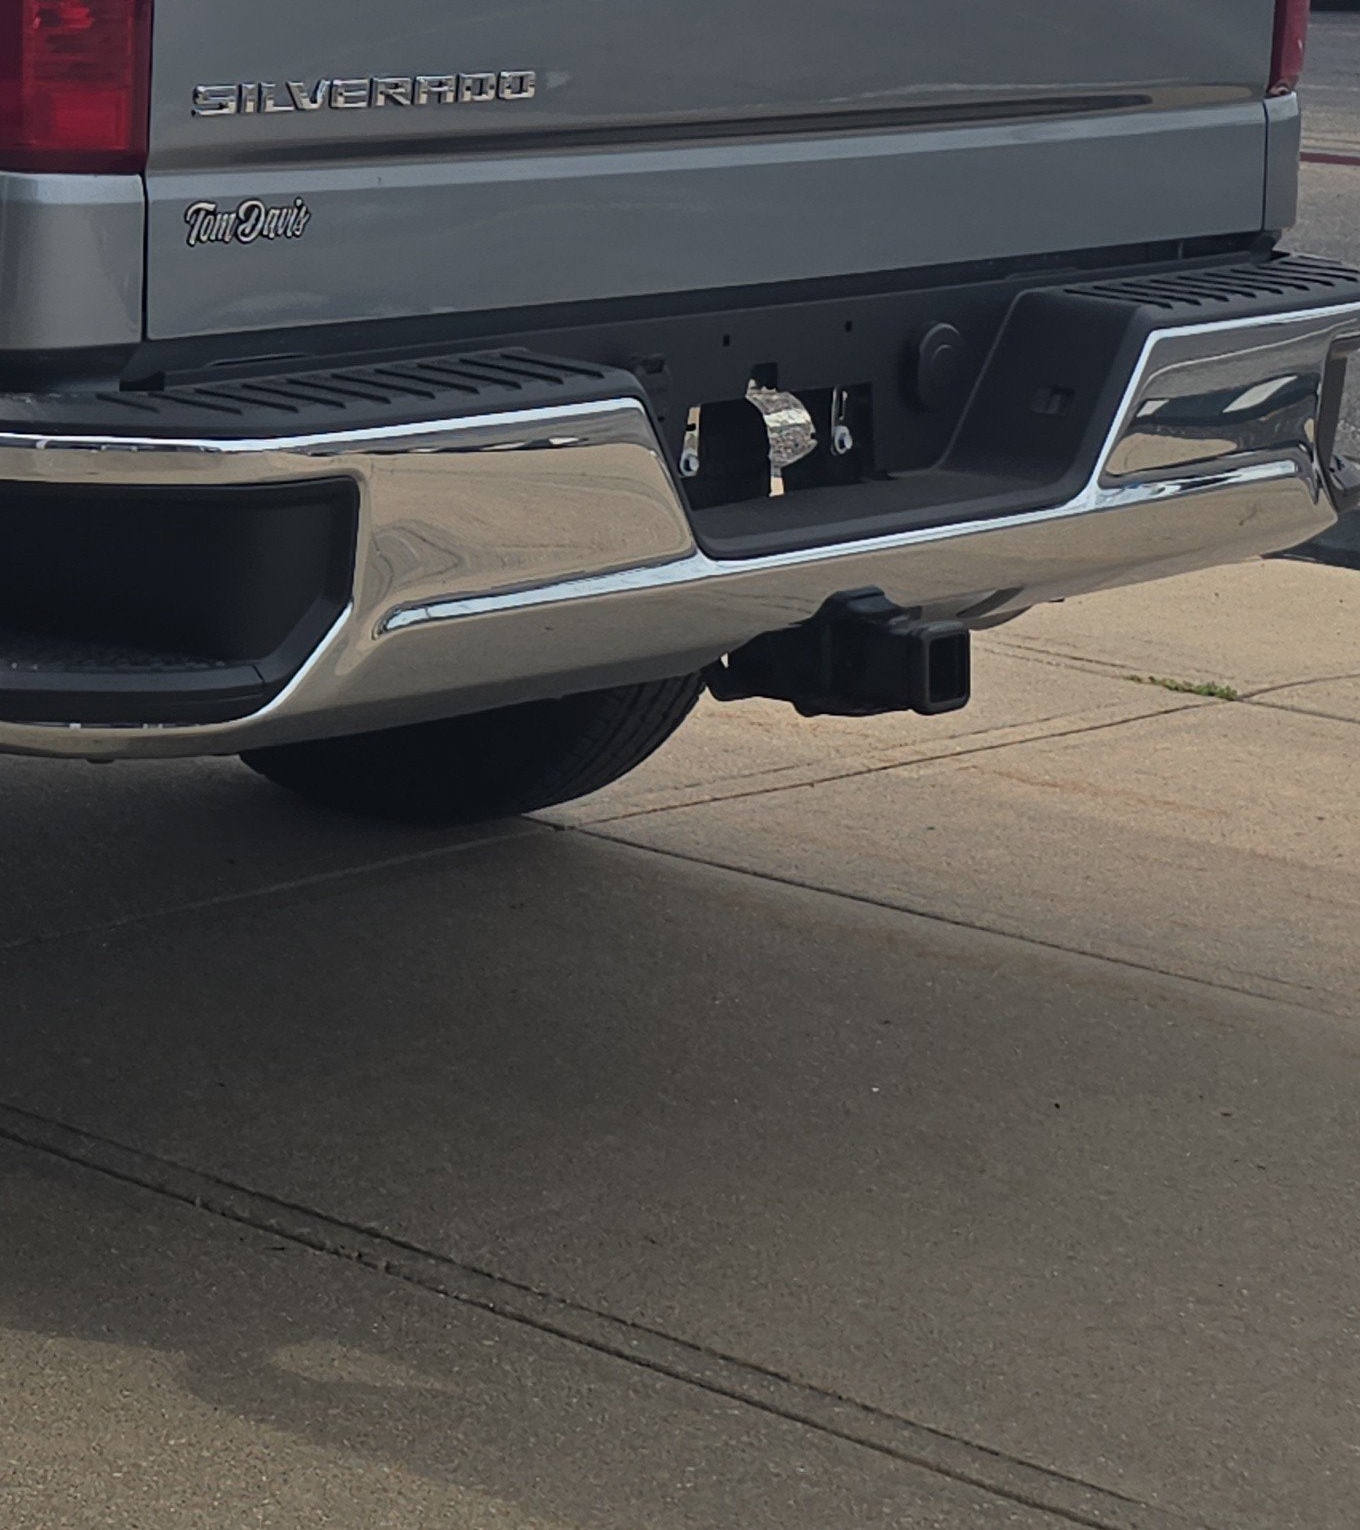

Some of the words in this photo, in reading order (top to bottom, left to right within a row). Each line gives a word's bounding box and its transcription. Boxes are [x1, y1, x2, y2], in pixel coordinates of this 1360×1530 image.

[192, 70, 536, 116] SILVERADO
[185, 201, 236, 247] Tom
[236, 196, 311, 244] Davis
